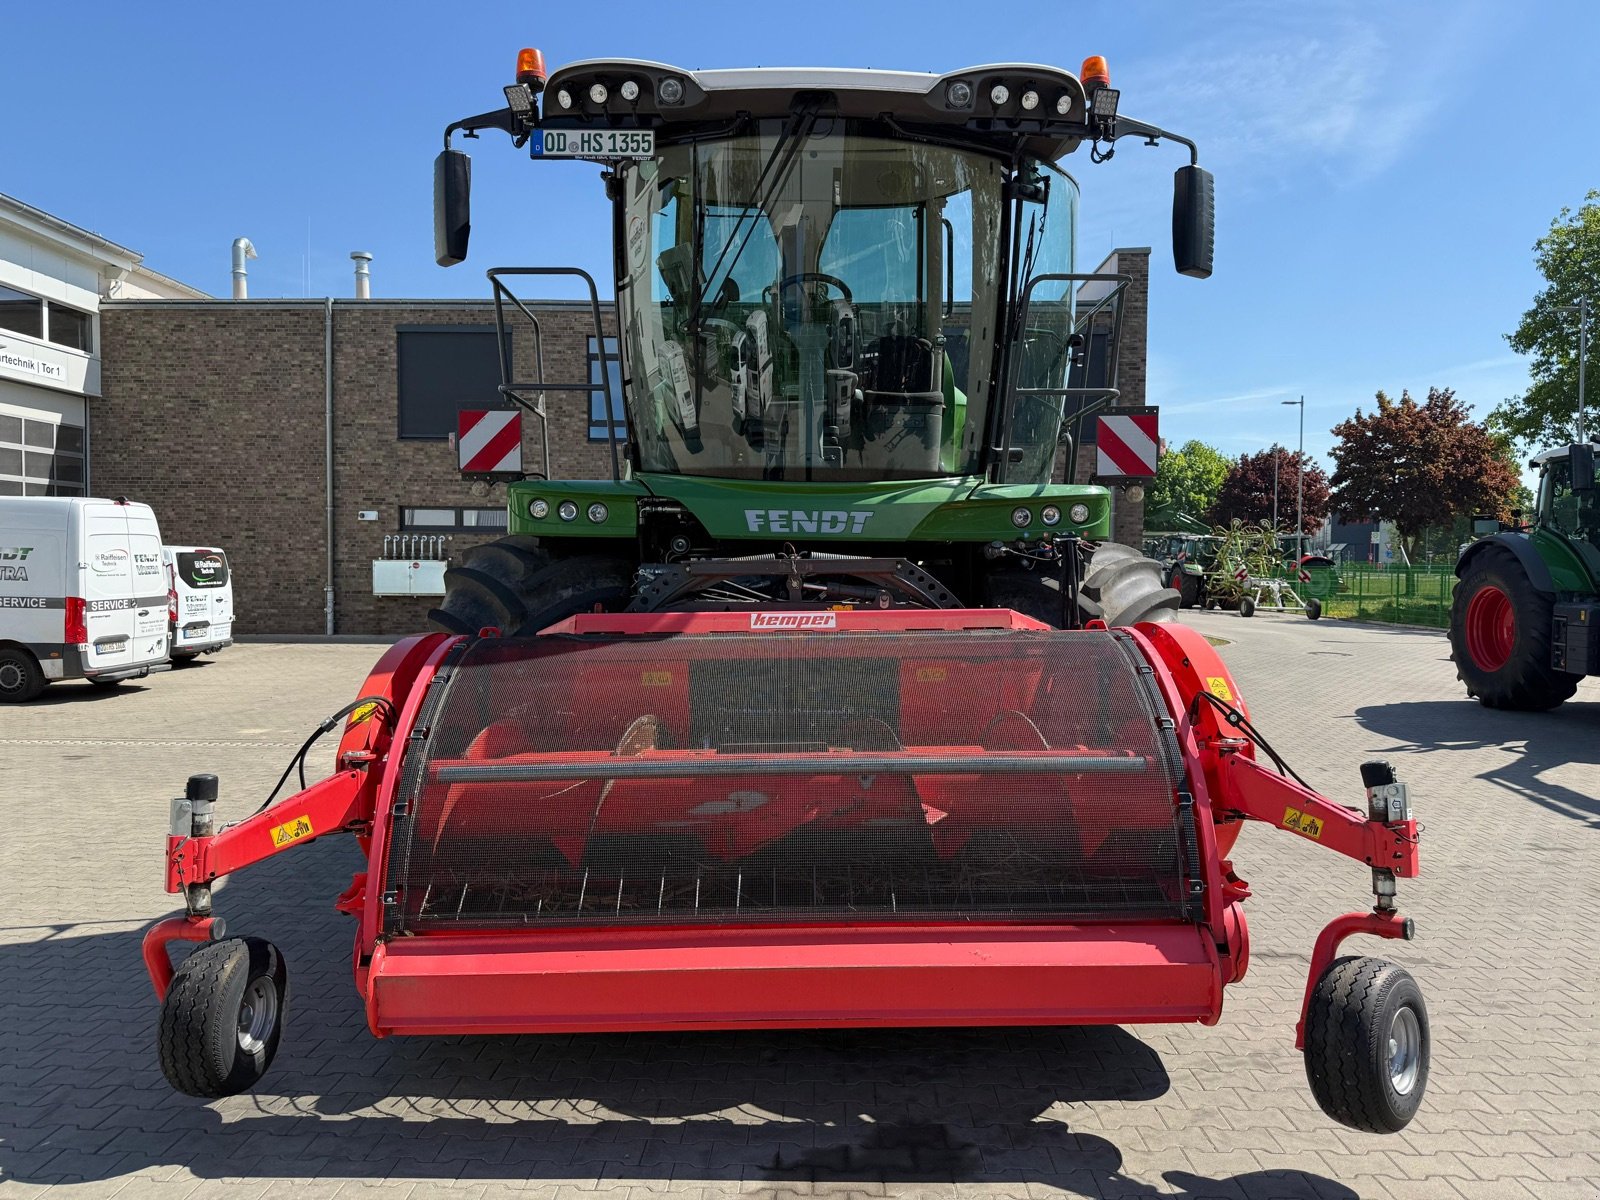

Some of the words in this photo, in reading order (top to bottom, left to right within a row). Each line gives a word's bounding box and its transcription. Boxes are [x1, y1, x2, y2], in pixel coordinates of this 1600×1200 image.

[544, 132, 567, 152] OD
[580, 132, 604, 153] HS
[607, 132, 652, 153] 1355
[0, 354, 35, 370] rtechnik
[41, 362, 55, 374] Tor
[56, 366, 60, 376] 1
[744, 509, 874, 534] FENDT
[100, 553, 127, 561] Raiffeisen
[133, 553, 159, 563] FENDT
[91, 599, 129, 611] SERVICE
[752, 613, 833, 628] kemper
